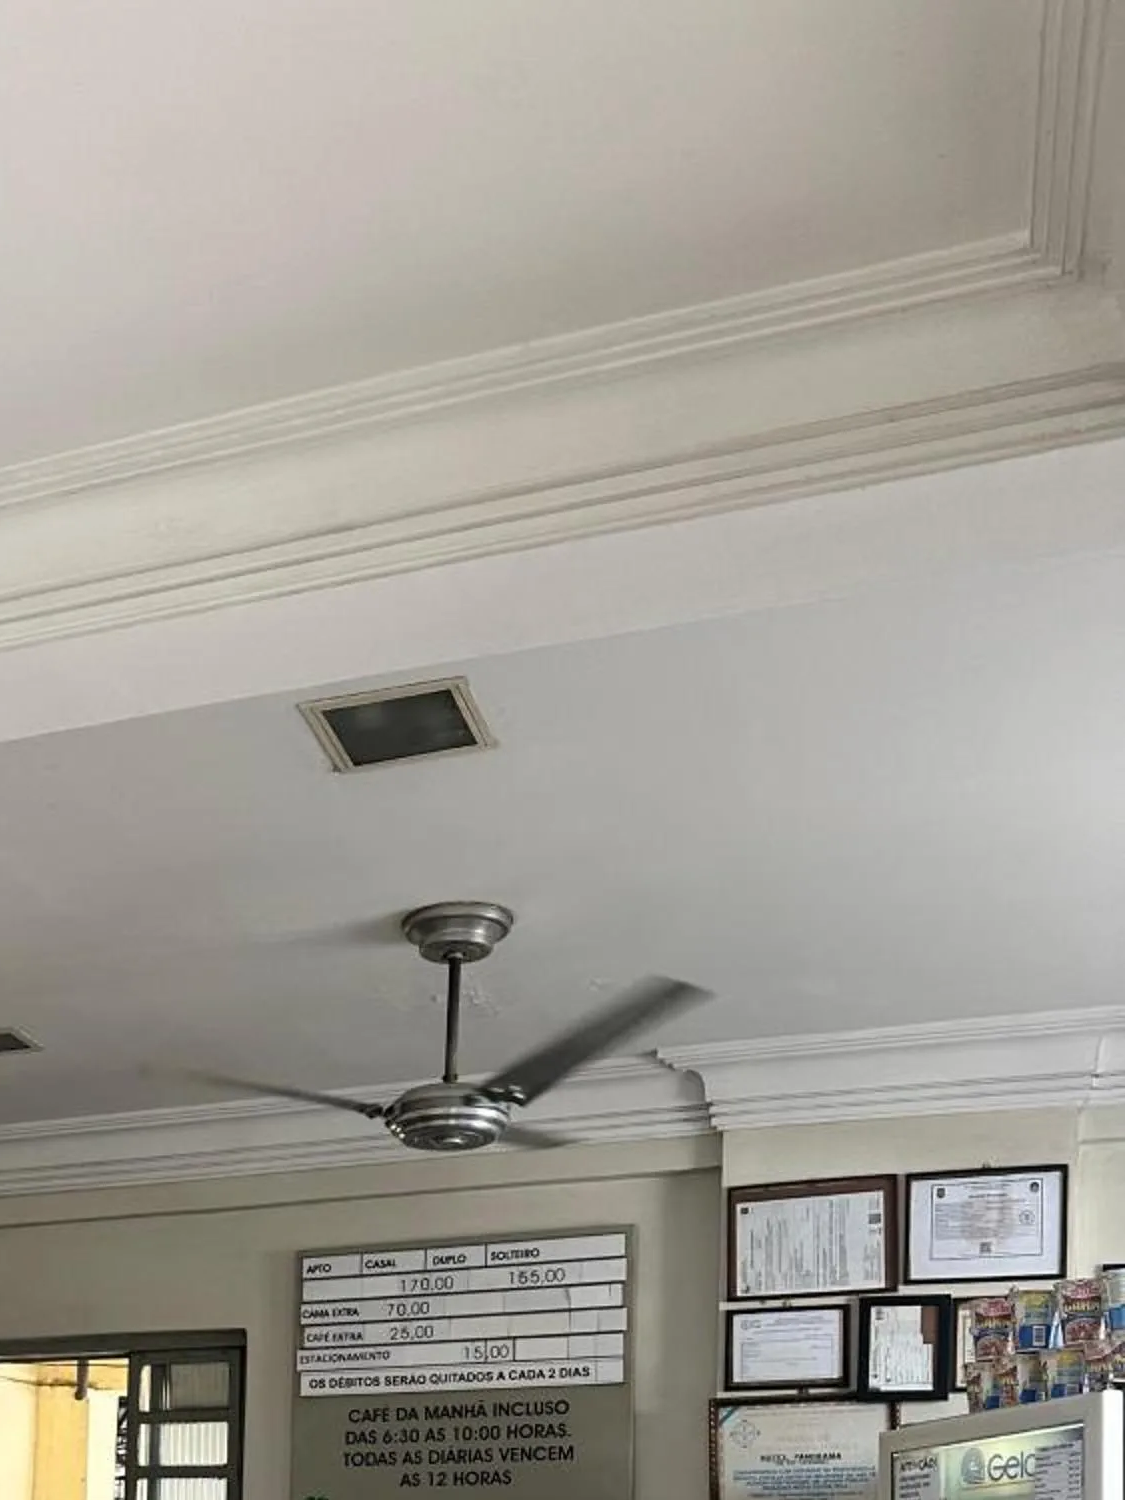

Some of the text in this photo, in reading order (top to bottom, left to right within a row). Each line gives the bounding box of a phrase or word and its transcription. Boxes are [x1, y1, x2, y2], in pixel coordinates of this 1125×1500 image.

[365, 1259, 397, 1269] CASAL
[432, 1254, 468, 1266] DUPLO
[490, 1248, 540, 1261] SOLTEIRO
[302, 1307, 360, 1319] CAMA EXTRA
[332, 1331, 364, 1342] EXTRA
[299, 1350, 391, 1365] ESTACIONAMENTO
[309, 1378, 326, 1389] OS
[429, 1370, 493, 1385] QUITADOS
[496, 1371, 506, 1381] A
[508, 1368, 546, 1380] CADA
[548, 1368, 557, 1379] 2
[559, 1366, 590, 1378] DIAS
[396, 1407, 419, 1421] DA
[424, 1400, 488, 1420] MANHÃ
[492, 1400, 570, 1417] INCLUSO
[345, 1430, 377, 1445] DAS
[382, 1428, 420, 1445] 6:30
[425, 1427, 446, 1442] AS
[453, 1425, 502, 1441] 10:00
[344, 1451, 397, 1467] TODAS
[402, 1450, 423, 1465] AS
[498, 1445, 575, 1463] VENCEM
[400, 1470, 513, 1487] AS 12 HORAS
